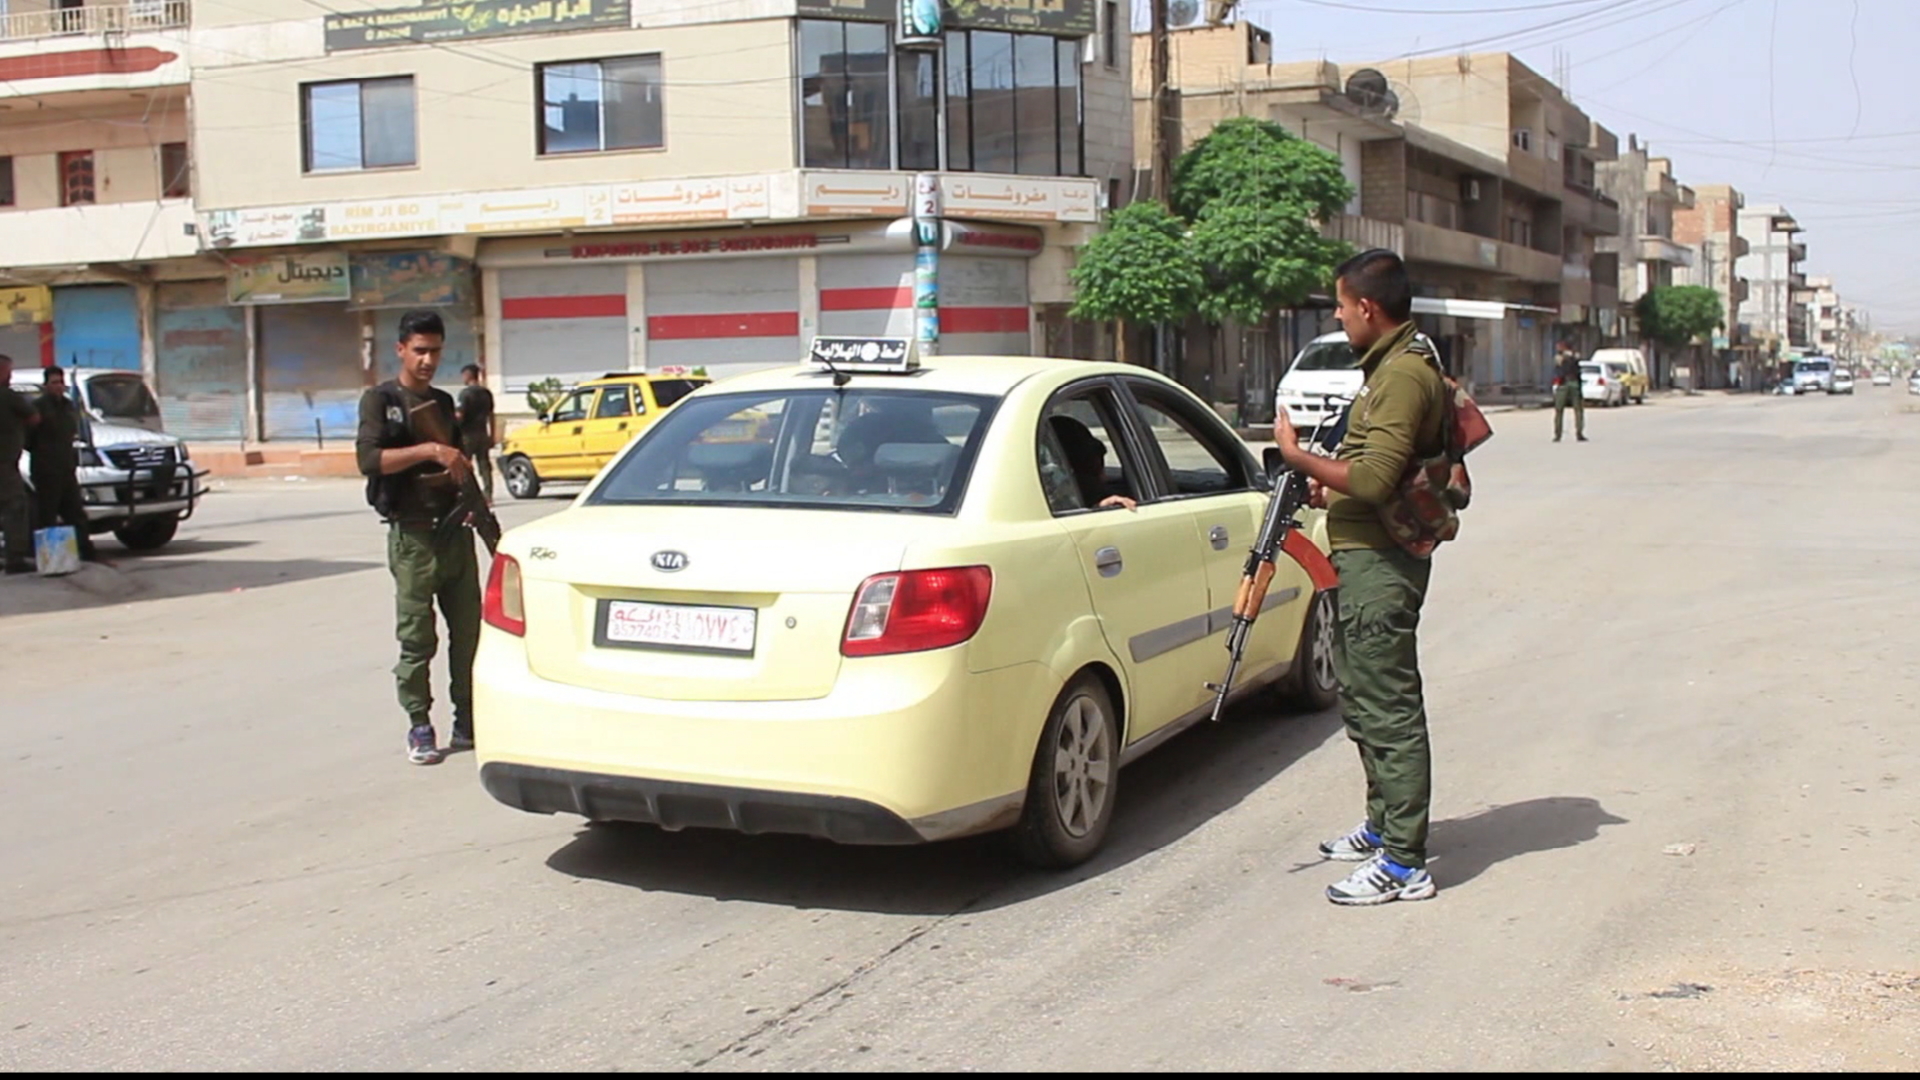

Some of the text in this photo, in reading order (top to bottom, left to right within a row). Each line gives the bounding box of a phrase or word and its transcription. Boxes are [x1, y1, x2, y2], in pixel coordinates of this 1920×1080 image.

[618, 183, 722, 204] مفروشات
[816, 184, 899, 201] ريم
[952, 184, 1047, 206] مفروشات
[398, 203, 420, 216] BO
[479, 198, 560, 216] ريم
[593, 208, 604, 220] 2
[925, 200, 936, 214] 2
[278, 255, 345, 283] ديجيتال
[815, 340, 905, 361] خط الهلالية
[529, 546, 557, 560] Rio
[654, 553, 684, 568] KIA
